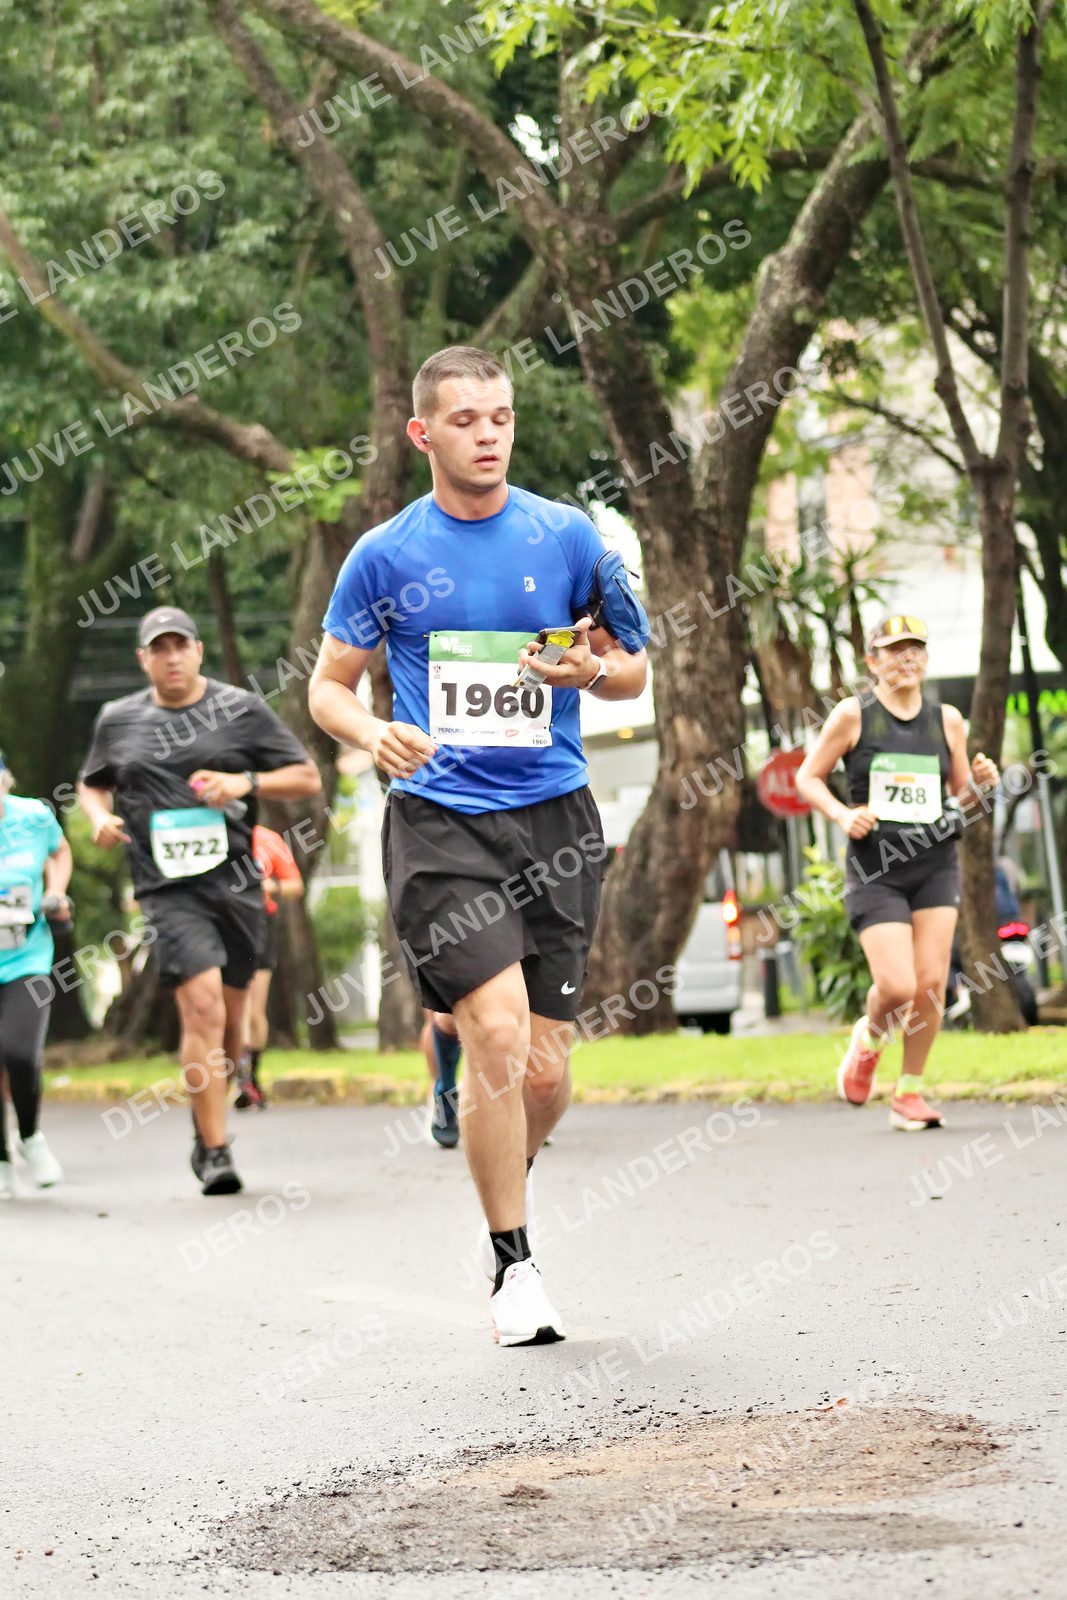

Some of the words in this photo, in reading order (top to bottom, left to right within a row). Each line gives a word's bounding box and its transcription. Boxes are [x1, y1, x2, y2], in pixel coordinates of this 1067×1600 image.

[441, 682, 545, 719] 1960
[885, 785, 926, 805] 788
[162, 838, 221, 860] 3722
